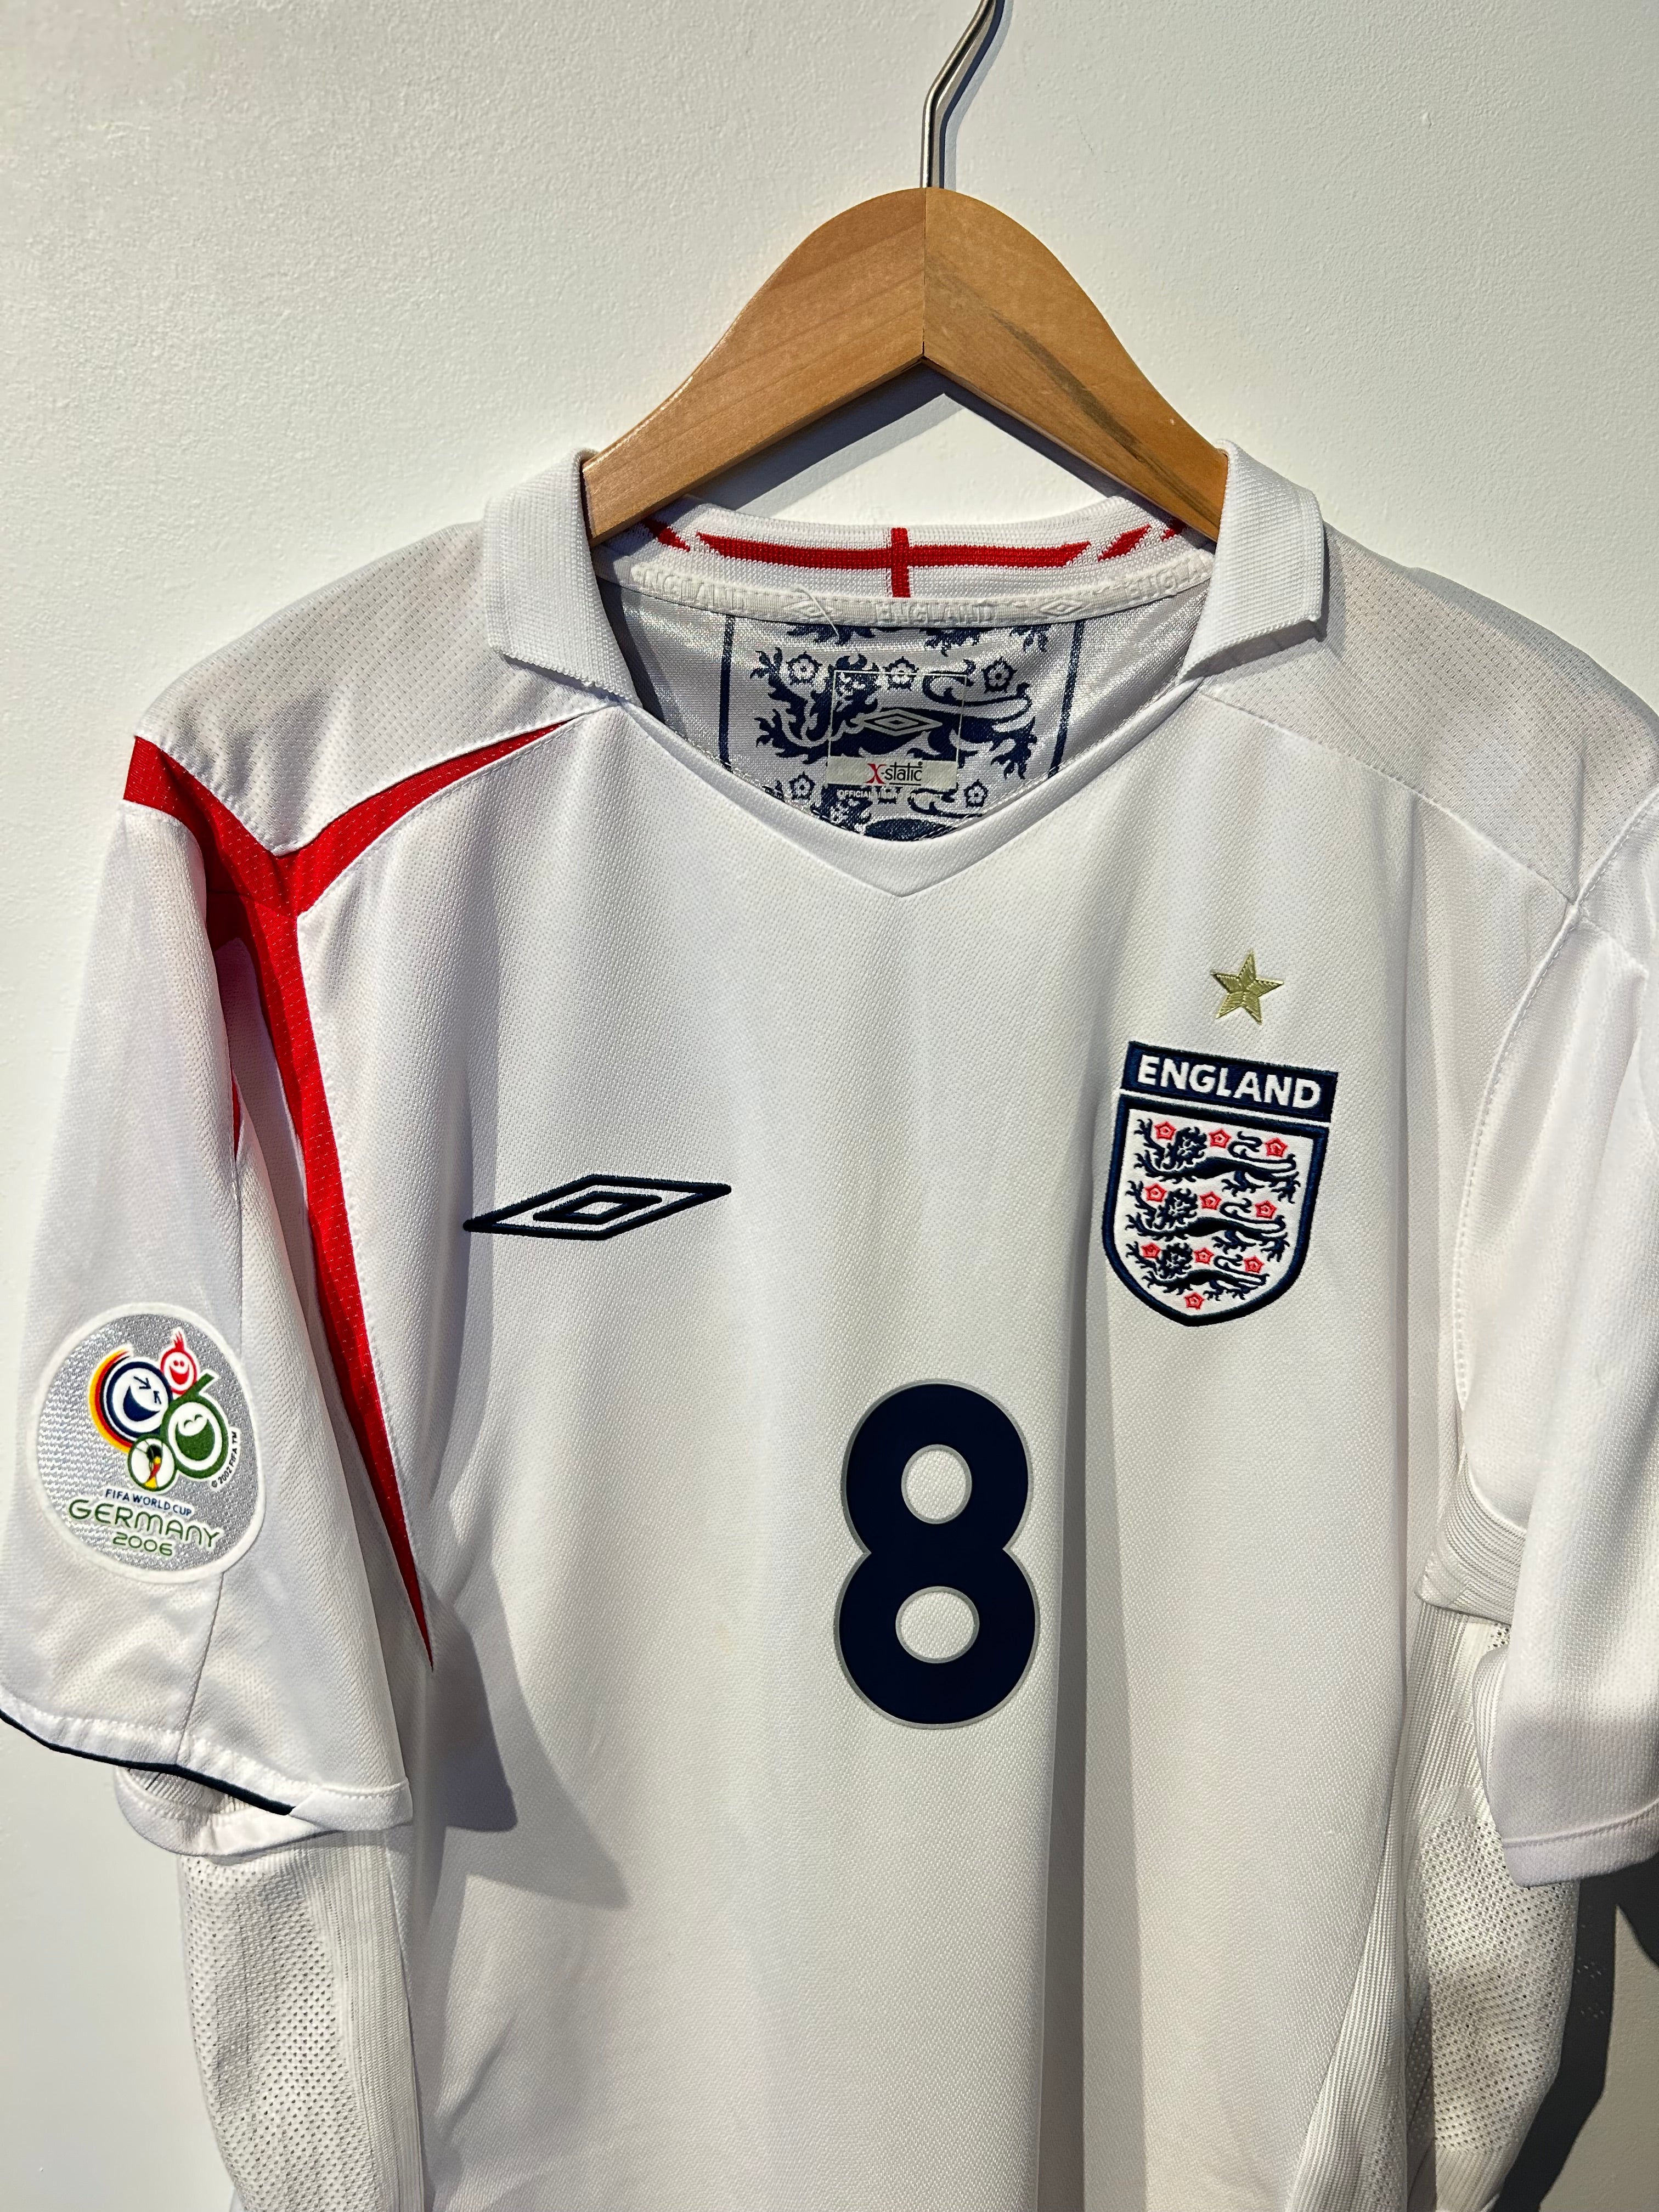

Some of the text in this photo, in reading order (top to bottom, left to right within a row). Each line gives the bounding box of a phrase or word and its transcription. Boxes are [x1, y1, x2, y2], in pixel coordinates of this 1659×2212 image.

[875, 602, 997, 624] ENGLAND
[838, 789, 872, 799] OFFICIAL
[1138, 1054, 1322, 1109] ENGLAND
[232, 1430, 238, 1444] TM
[229, 1447, 238, 1468] FIFA
[218, 1466, 233, 1485] 2002
[105, 1488, 193, 1517] FIFA WORLD CUP
[68, 1498, 220, 1548] GERMANY
[112, 1531, 173, 1557] 2006
[833, 1378, 1040, 1730] 8
